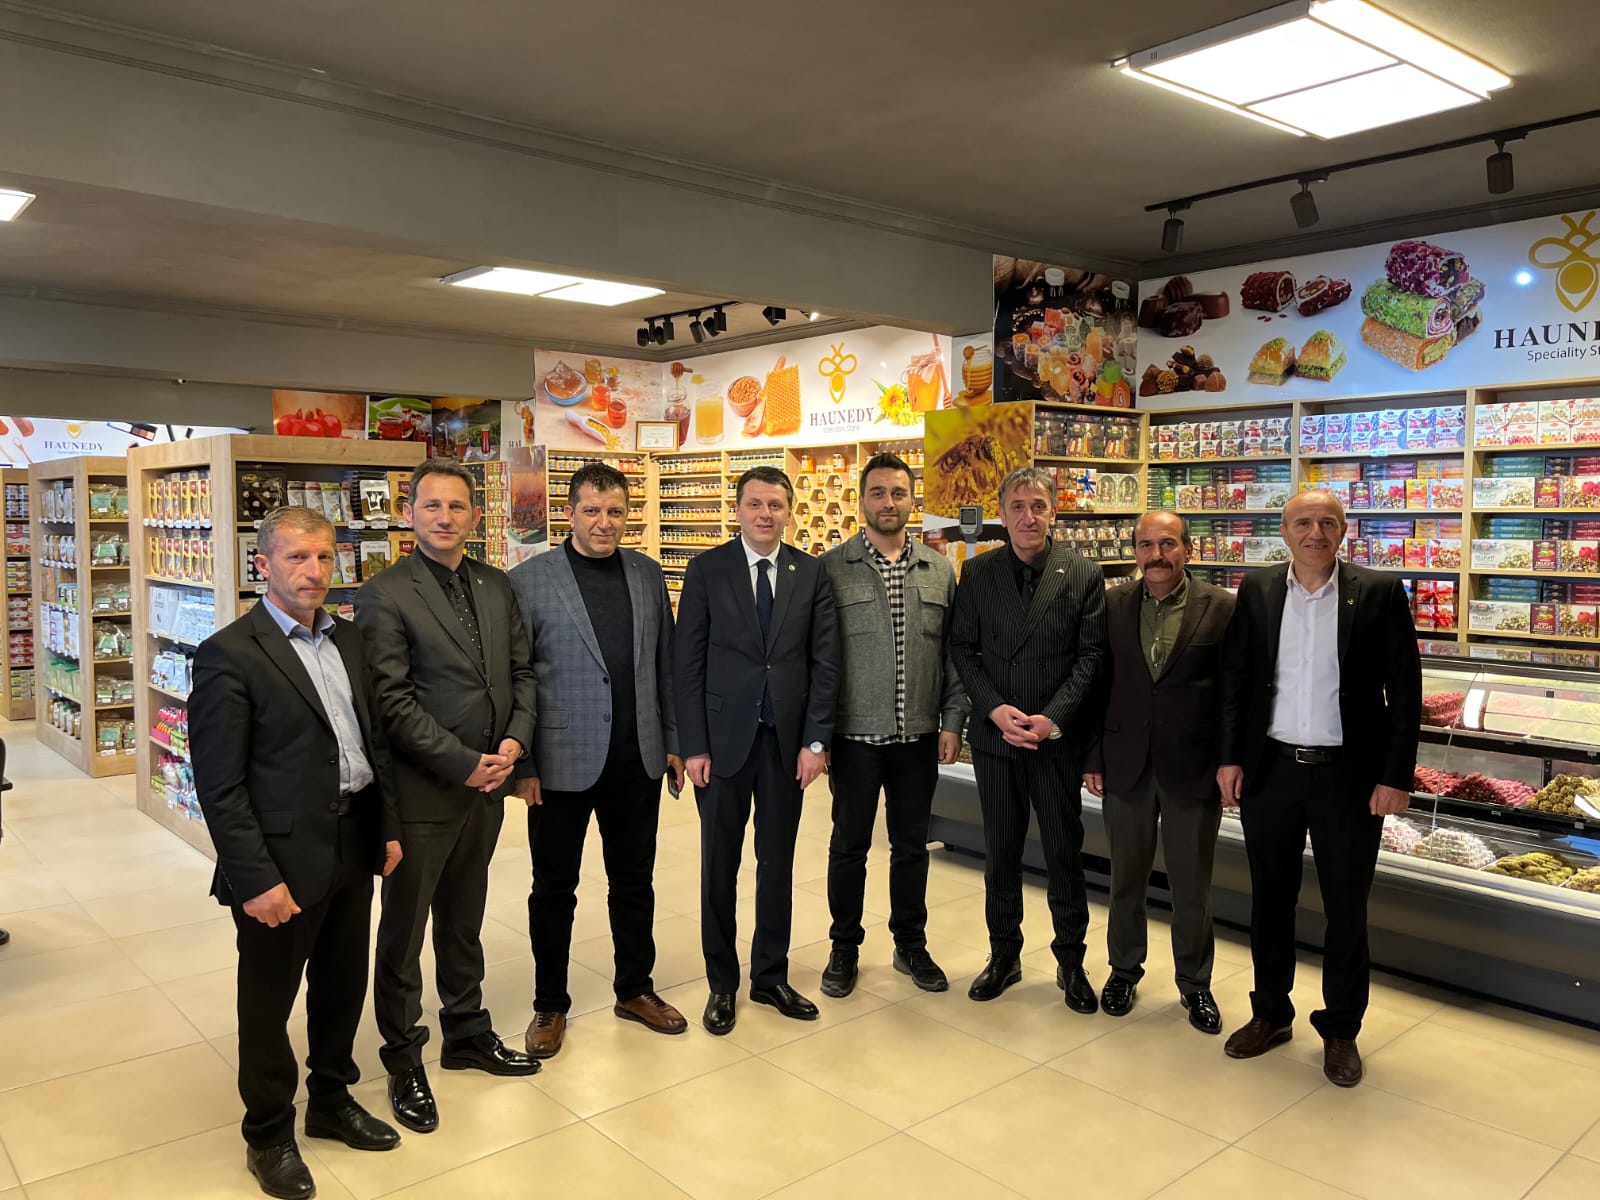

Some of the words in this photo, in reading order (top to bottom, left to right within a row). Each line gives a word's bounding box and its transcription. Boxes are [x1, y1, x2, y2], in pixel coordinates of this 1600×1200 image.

[1527, 346, 1587, 363] Speciality
[810, 407, 874, 427] HAUNEDY
[44, 440, 104, 451] HAUNEDY
